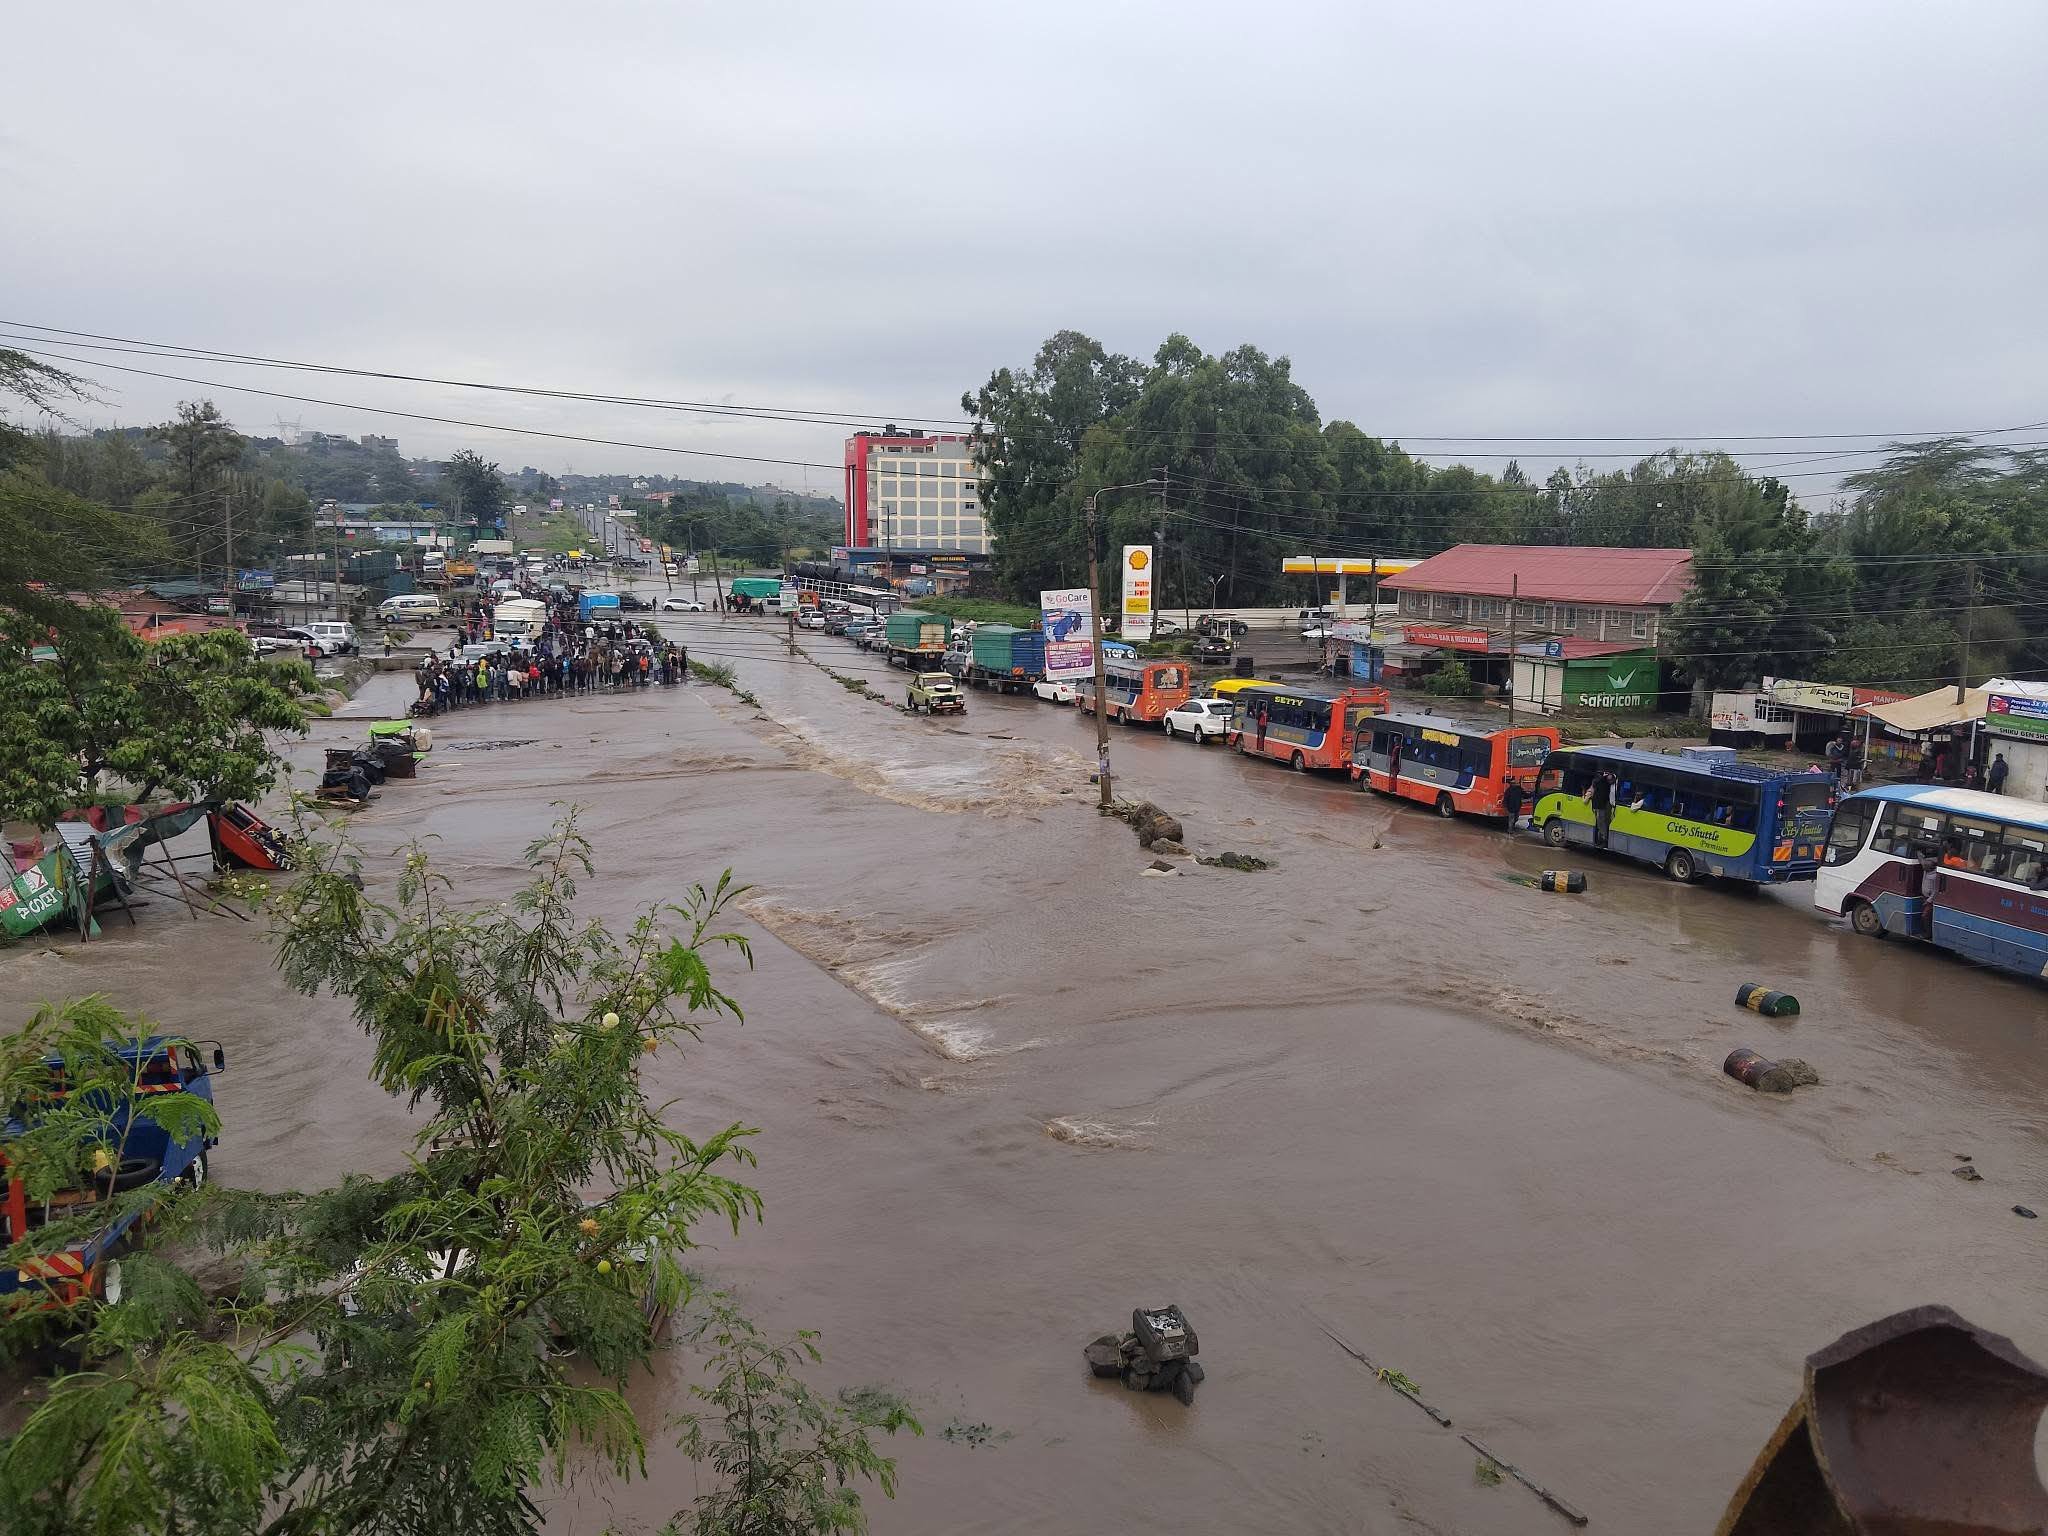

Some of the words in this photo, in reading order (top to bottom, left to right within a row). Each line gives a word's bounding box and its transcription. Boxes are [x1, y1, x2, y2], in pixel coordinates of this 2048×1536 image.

[1055, 593, 1088, 602] GoCare
[1105, 648, 1125, 658] TOP
[1579, 691, 1641, 707] Safaricom
[1816, 689, 1850, 700] AMG
[1873, 695, 1899, 704] MANY
[1274, 695, 1304, 707] SETTY
[1712, 713, 1733, 721] HOTEL
[1666, 821, 1688, 836] City
[1688, 826, 1720, 841] Shuttle
